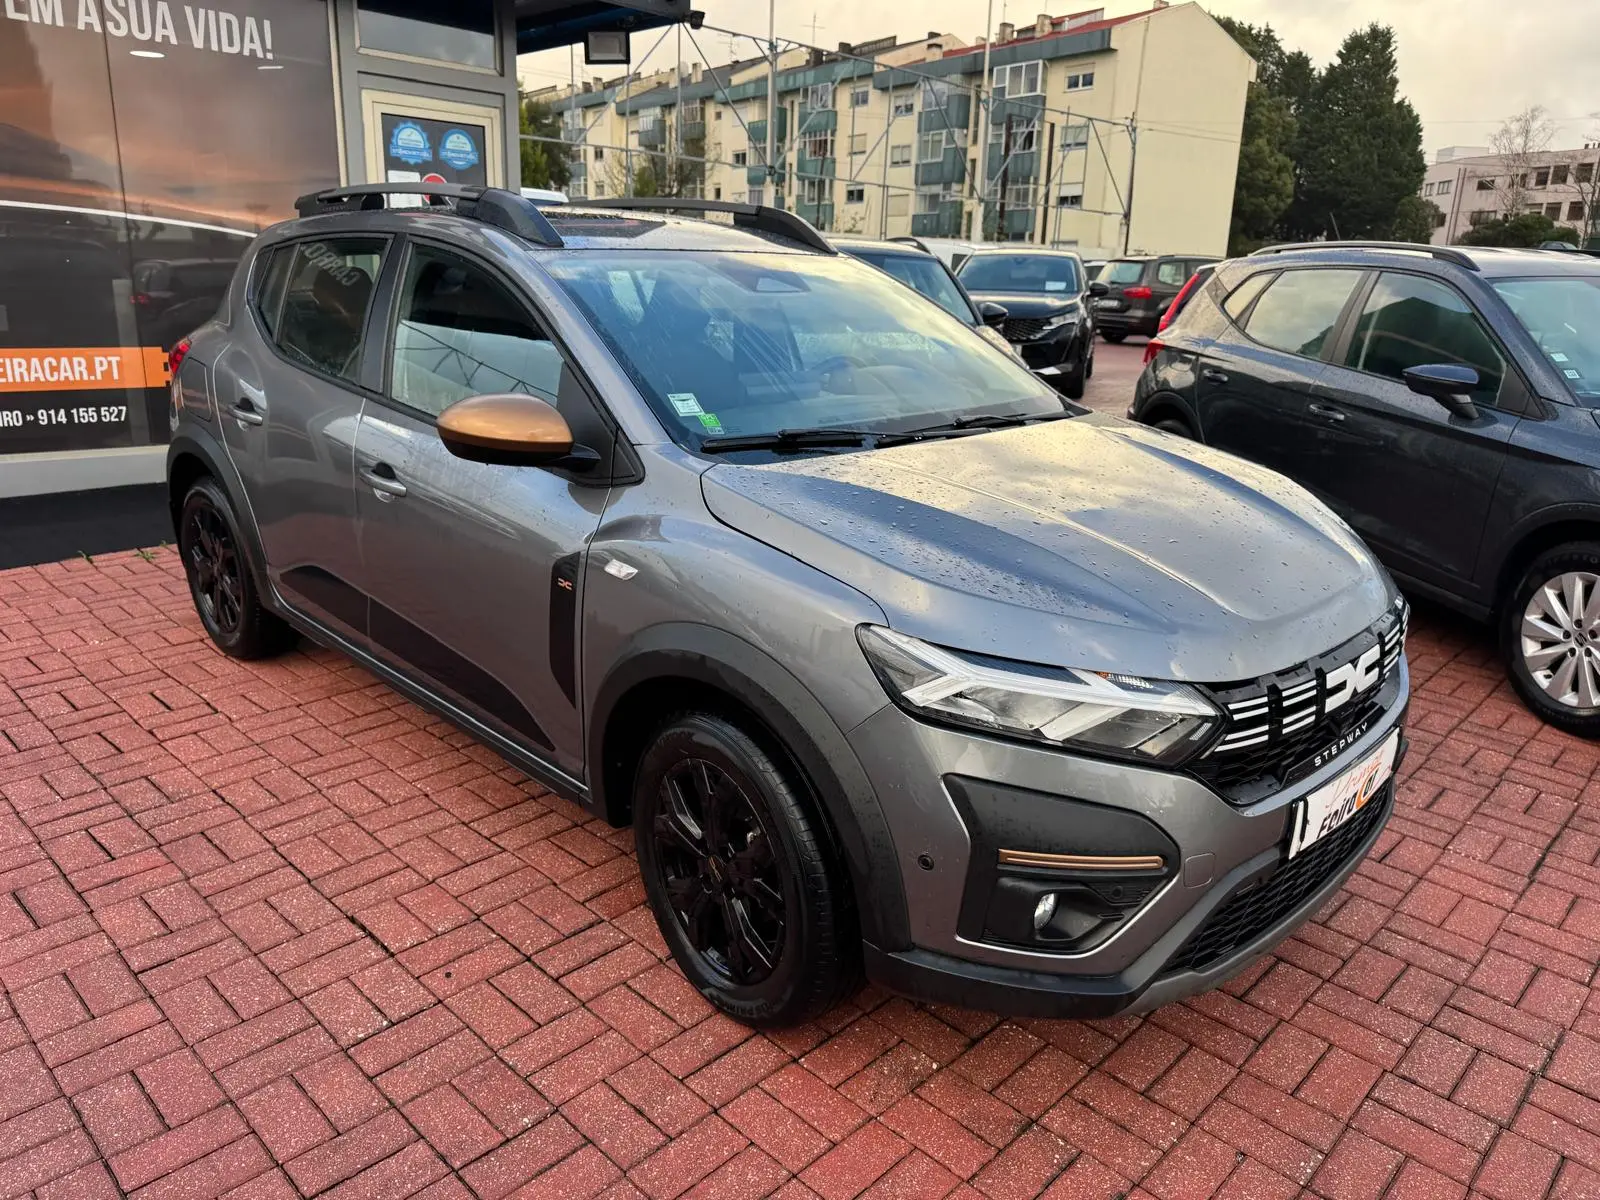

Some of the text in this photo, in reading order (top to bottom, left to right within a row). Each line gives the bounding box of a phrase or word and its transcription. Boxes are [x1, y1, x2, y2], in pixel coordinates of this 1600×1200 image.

[184, 5, 274, 60] VIDA!
[37, 408, 68, 425] 914
[70, 406, 98, 424] 155
[101, 405, 127, 422] 527
[1314, 722, 1368, 767] STEPWAY
